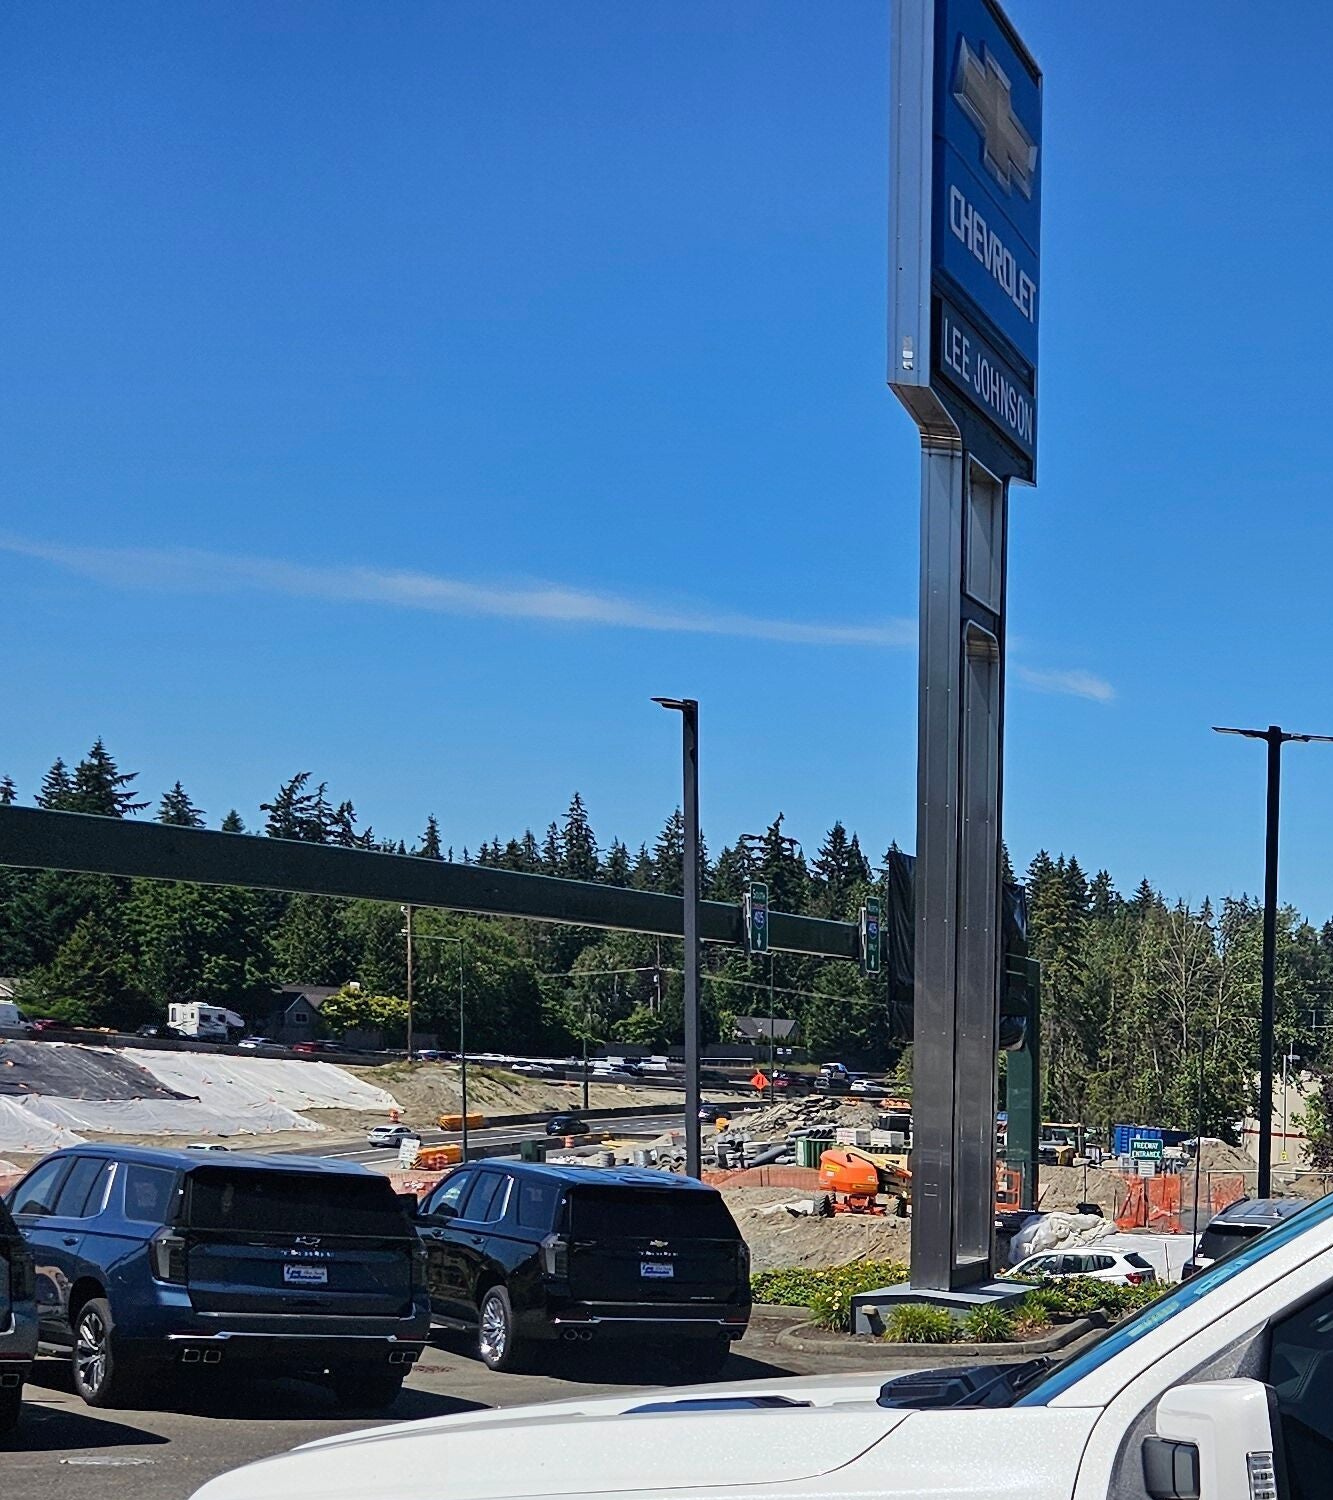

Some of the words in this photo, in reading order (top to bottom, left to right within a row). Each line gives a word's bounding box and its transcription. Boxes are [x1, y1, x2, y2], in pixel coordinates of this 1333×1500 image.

[950, 184, 1037, 324] CHEVROLET
[944, 318, 970, 383] LEE
[973, 352, 1033, 446] JOHNSON
